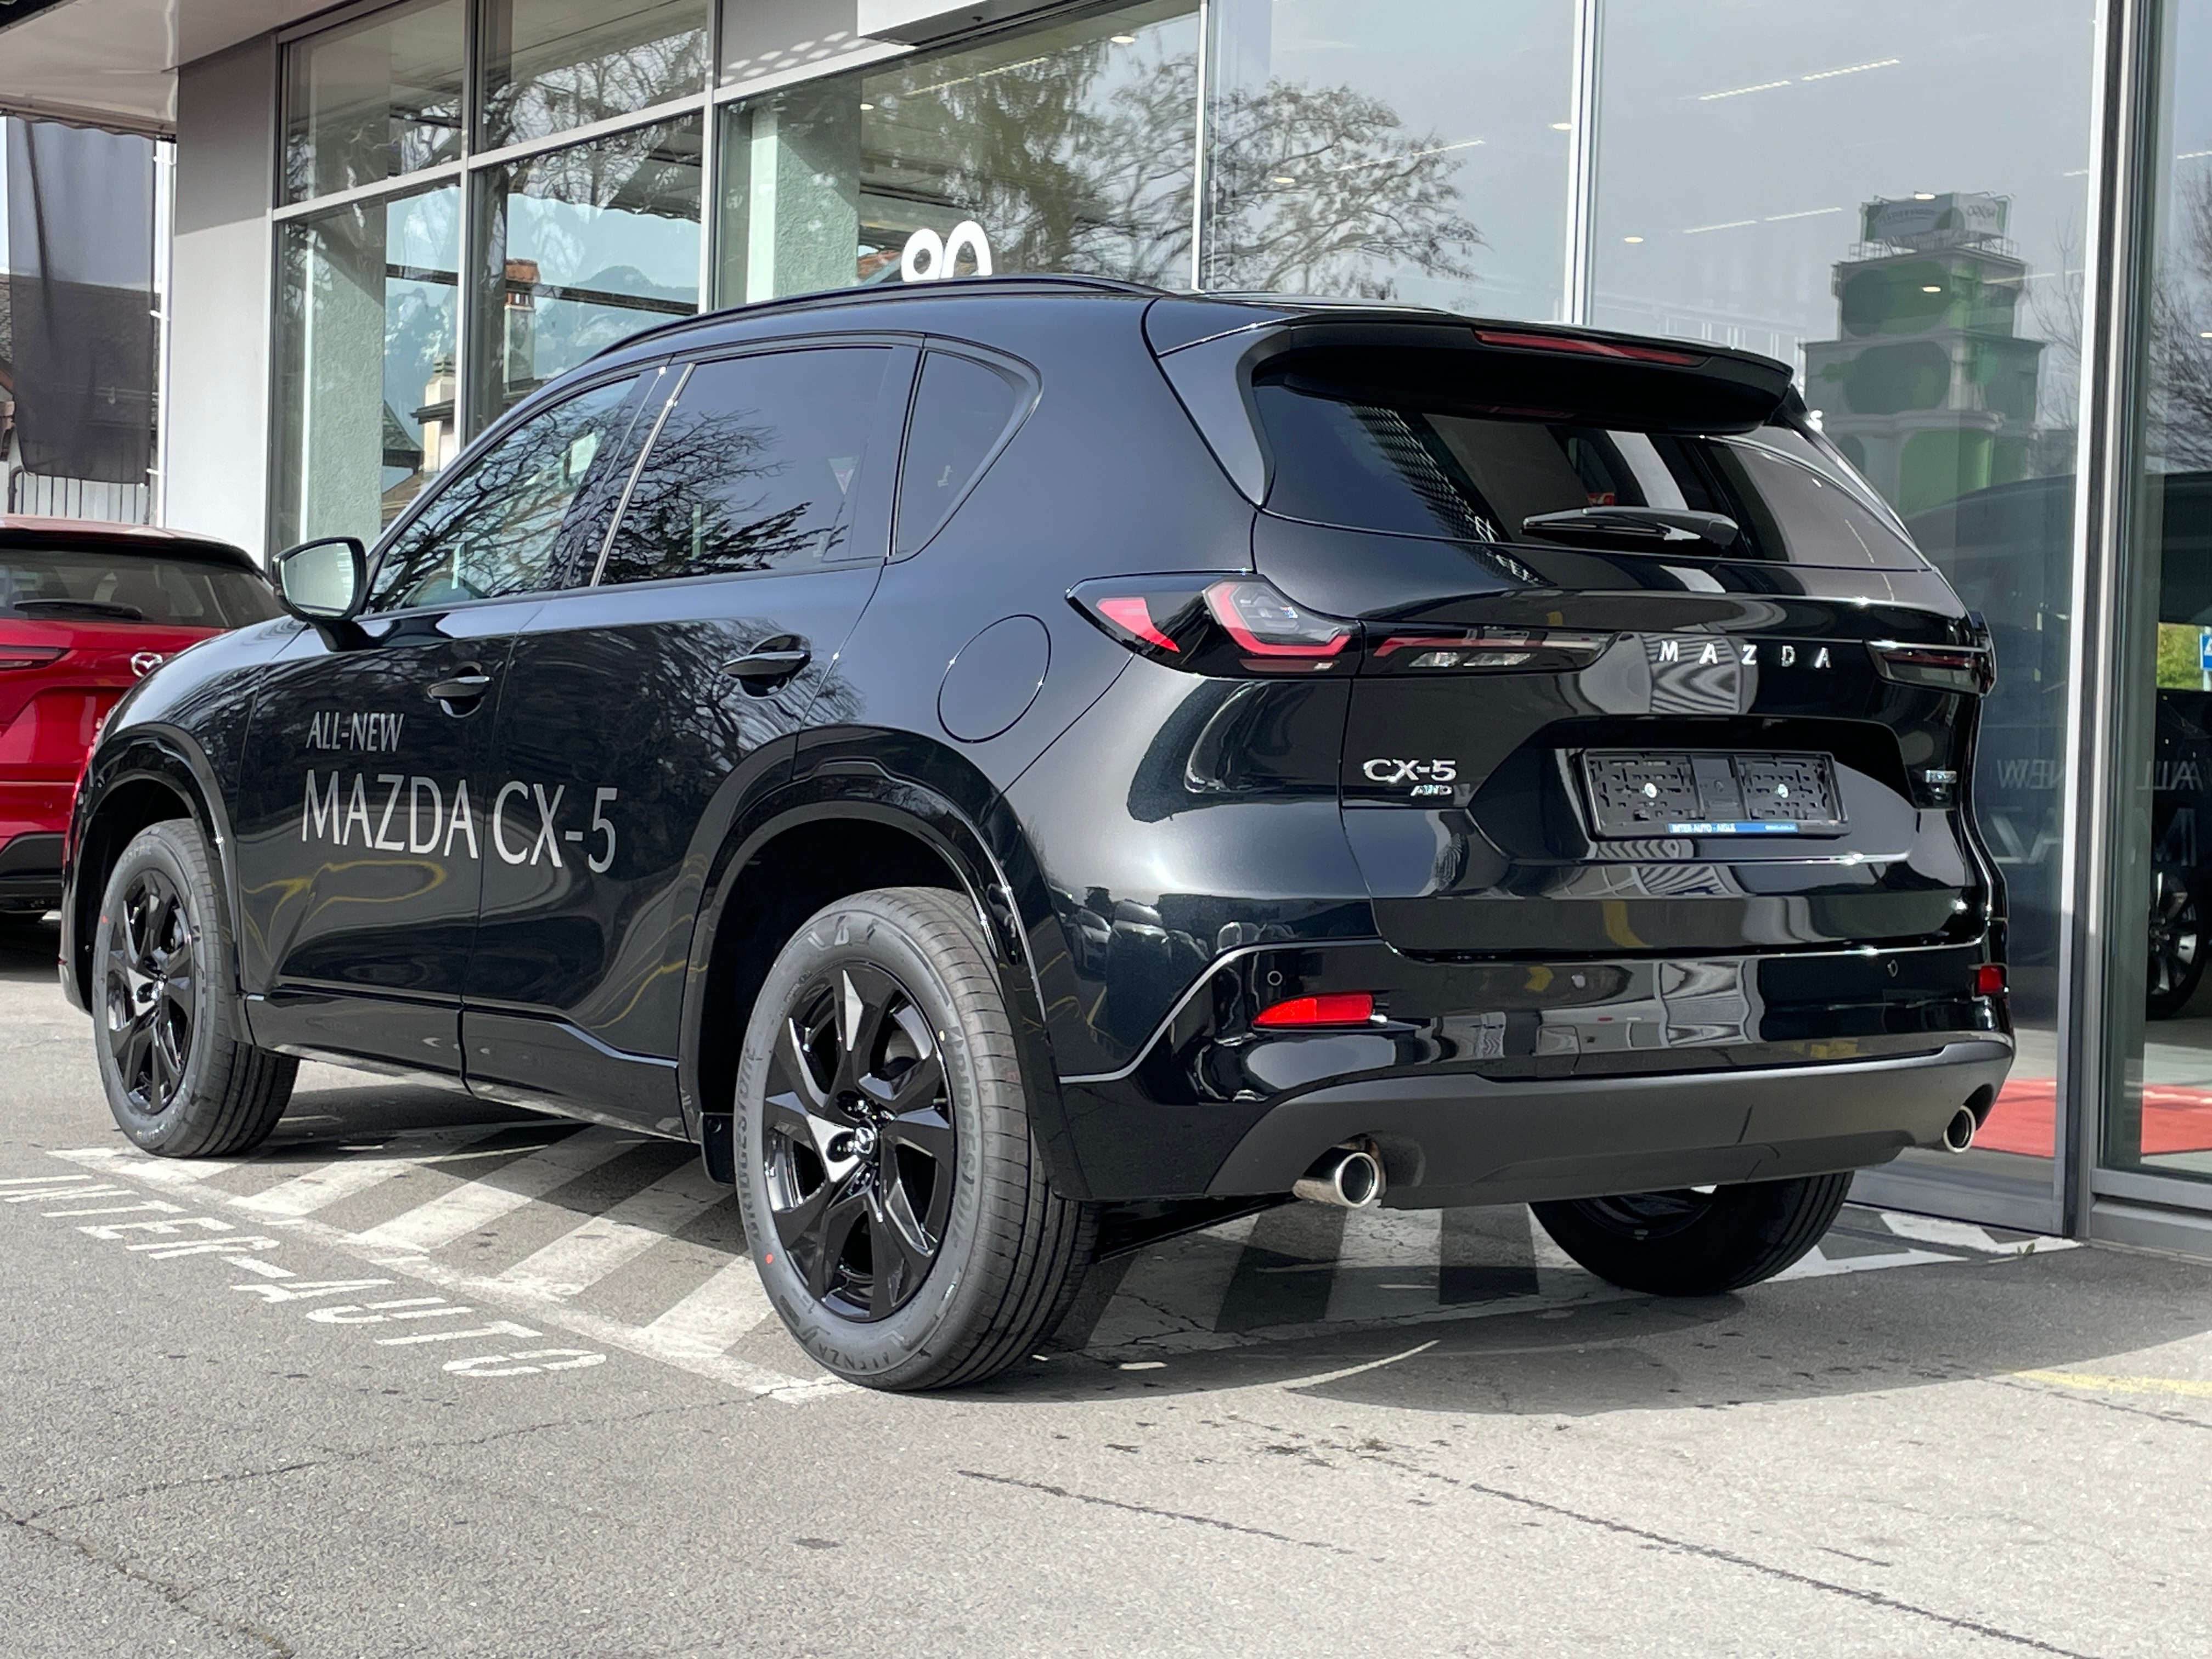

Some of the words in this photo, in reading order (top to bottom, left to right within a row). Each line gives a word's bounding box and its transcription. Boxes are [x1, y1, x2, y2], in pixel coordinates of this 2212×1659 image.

[1658, 640, 1831, 669] MAZDA
[306, 711, 404, 752] ALL-NEW
[1363, 758, 1457, 782] CX-5
[1410, 784, 1453, 797] AWD
[301, 769, 479, 859] MAZDA
[493, 780, 618, 873] CX-5
